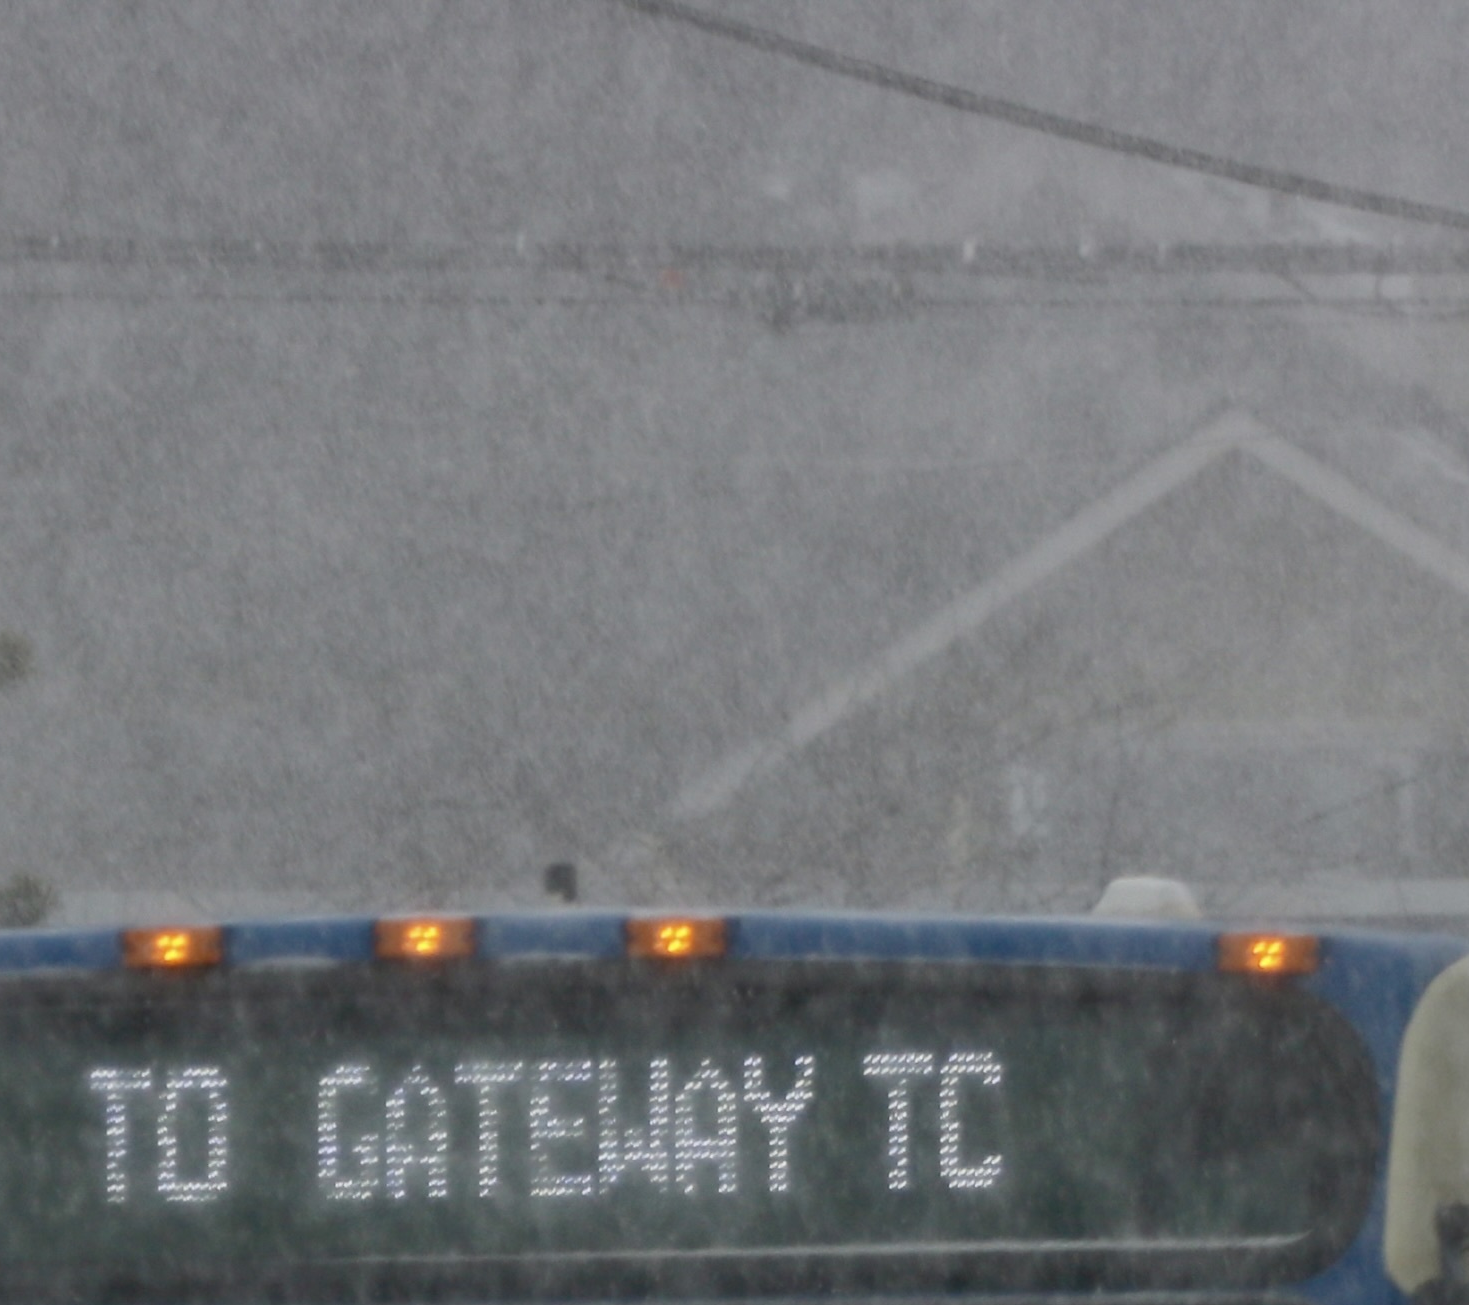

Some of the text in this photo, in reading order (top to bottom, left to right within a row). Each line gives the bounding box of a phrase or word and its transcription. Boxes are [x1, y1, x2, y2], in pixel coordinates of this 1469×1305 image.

[89, 1065, 229, 1202] TO
[317, 1055, 815, 1200] GATEWAY
[863, 1052, 1003, 1190] TC
